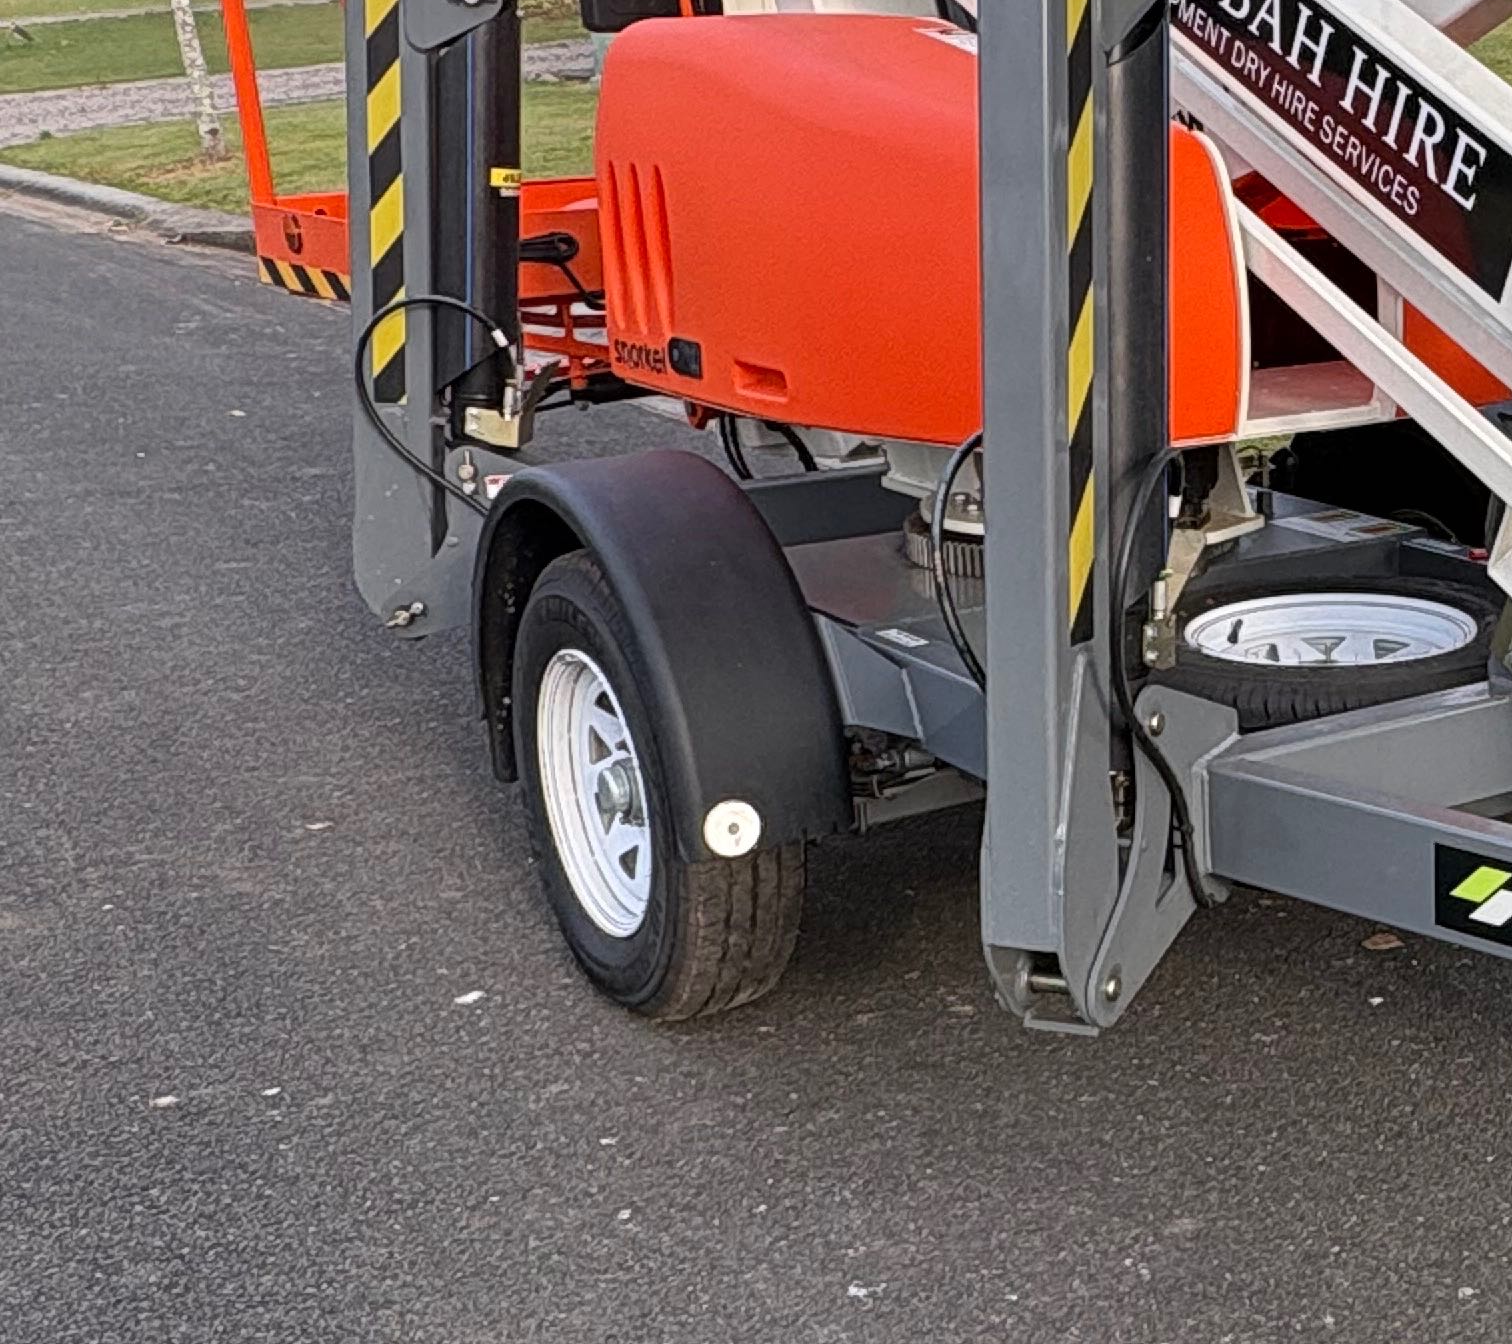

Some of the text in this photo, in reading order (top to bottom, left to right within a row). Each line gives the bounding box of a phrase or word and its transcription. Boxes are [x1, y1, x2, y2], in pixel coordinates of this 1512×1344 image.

[1230, 40, 1272, 89] DRY
[1270, 72, 1320, 133] HIRE
[1319, 114, 1421, 216] SERVICES
[1339, 46, 1488, 212] HIRE
